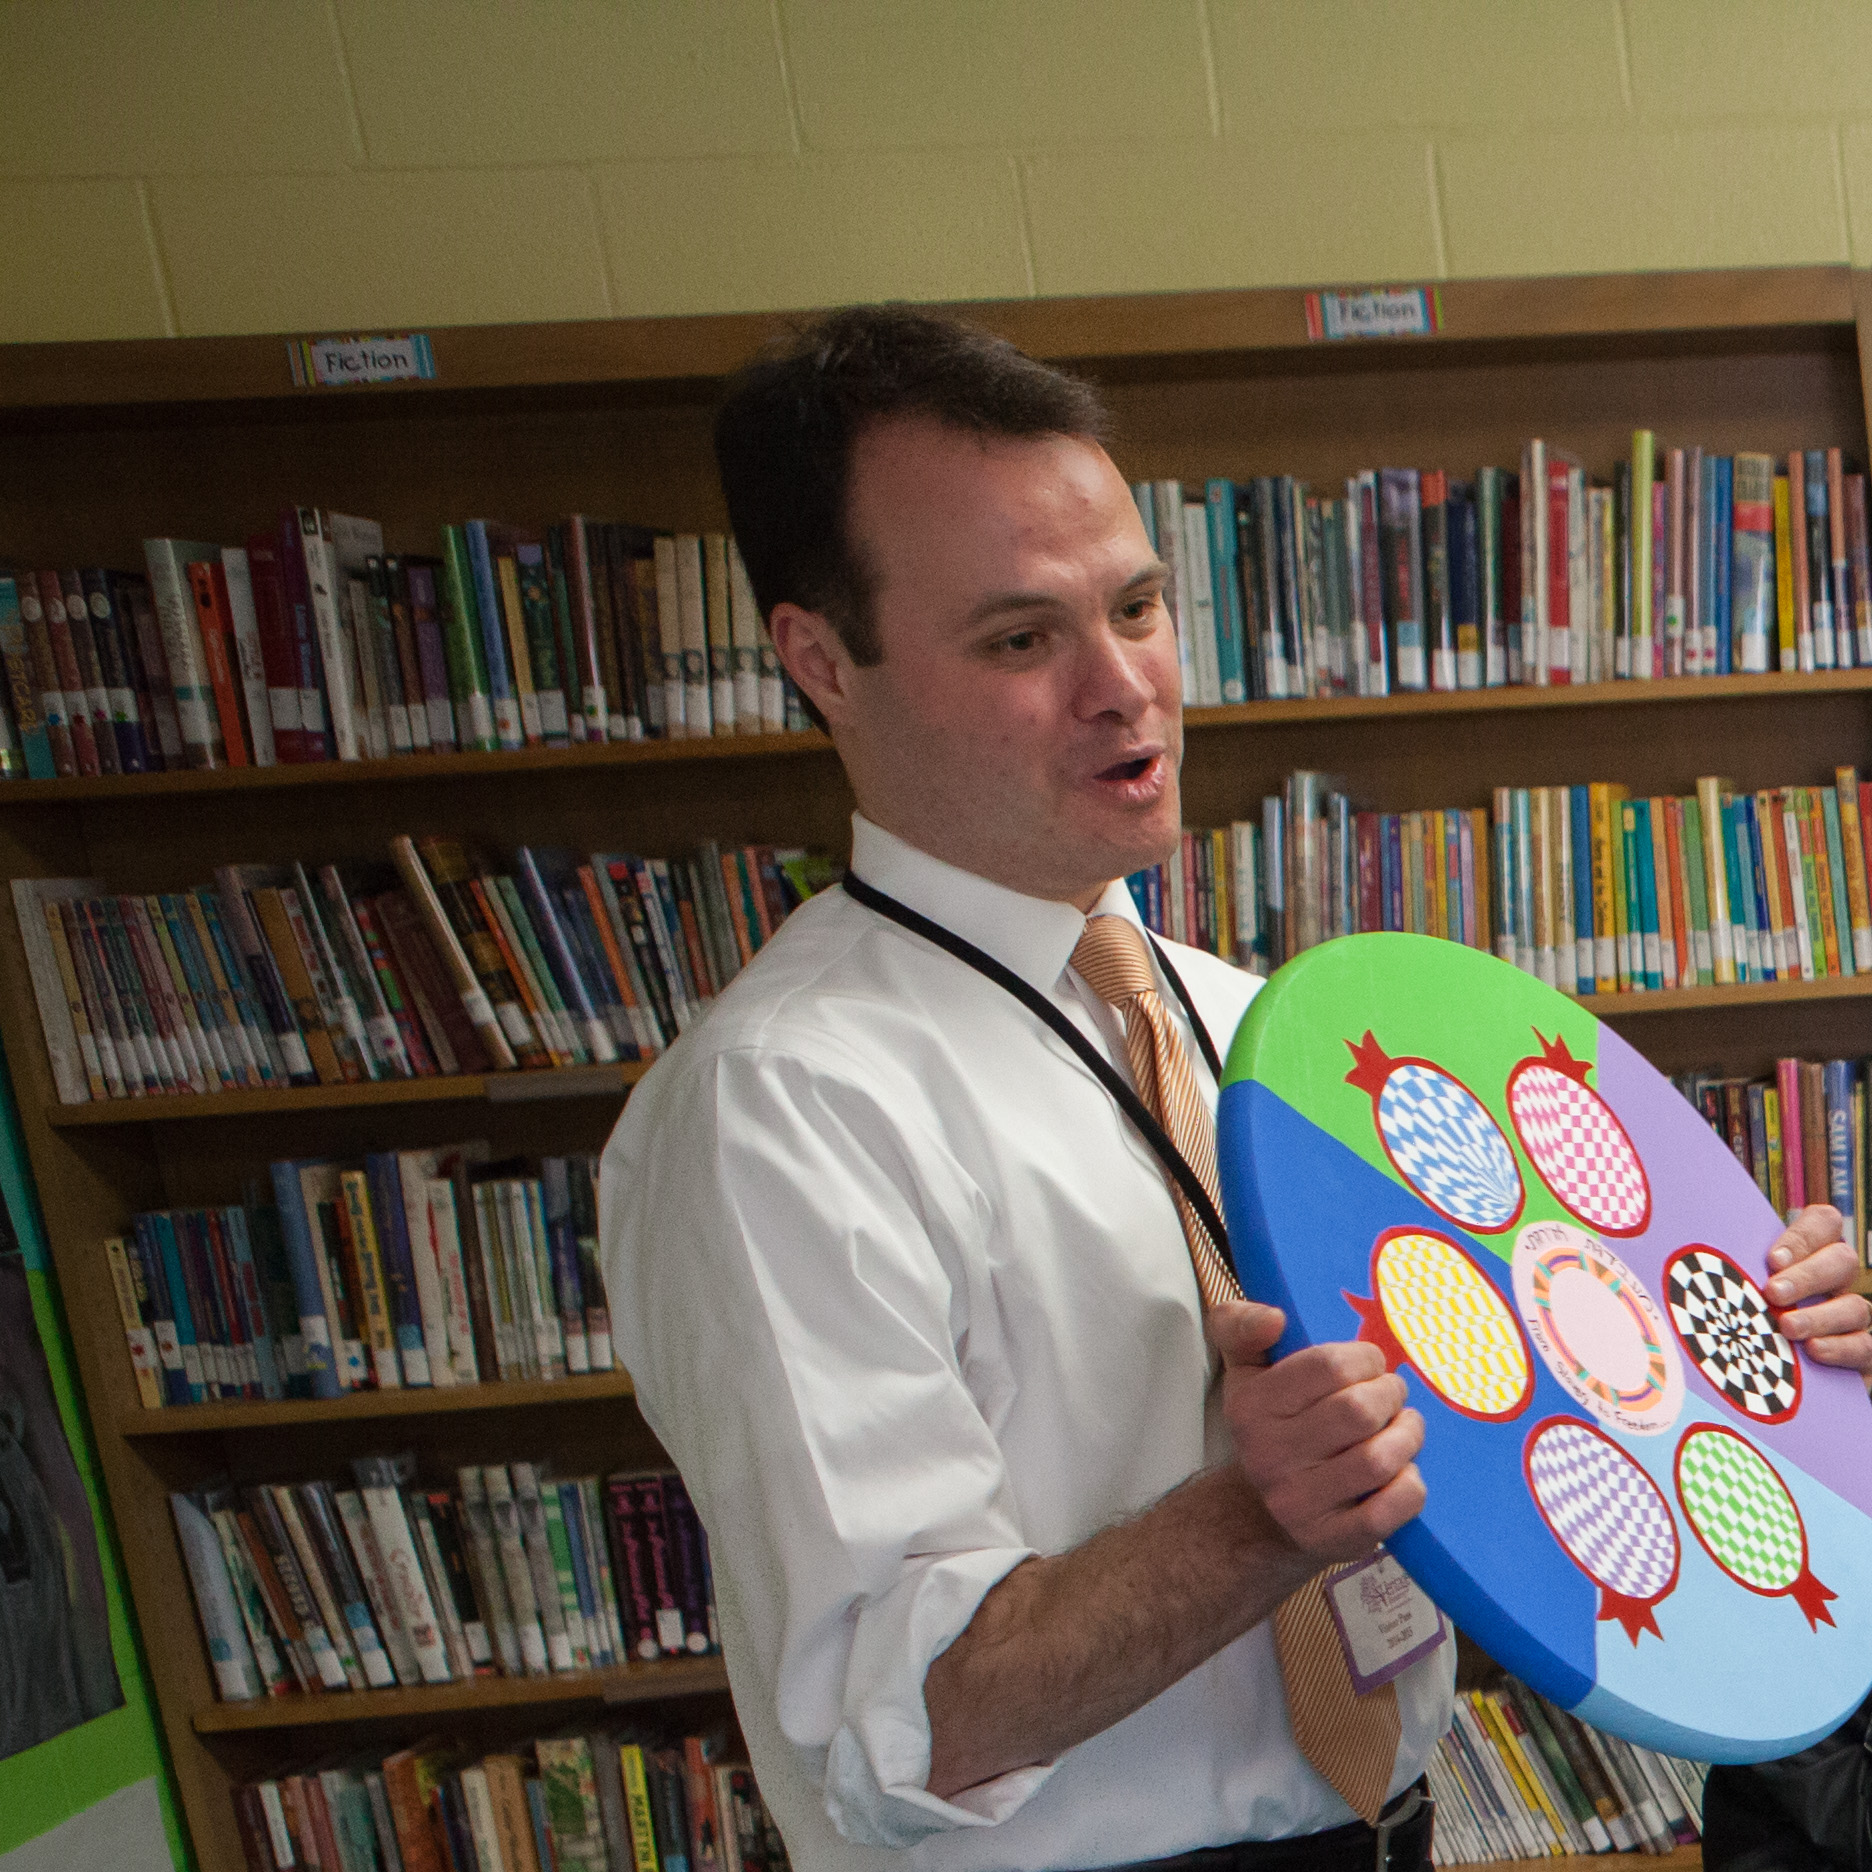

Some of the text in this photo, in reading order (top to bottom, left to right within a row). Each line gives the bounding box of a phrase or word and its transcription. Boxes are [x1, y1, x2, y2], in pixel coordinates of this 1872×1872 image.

[1339, 299, 1416, 322] Fiction
[324, 349, 410, 375] Fiction
[1827, 1109, 1847, 1151] SAM
[1830, 1166, 1848, 1196] AM
